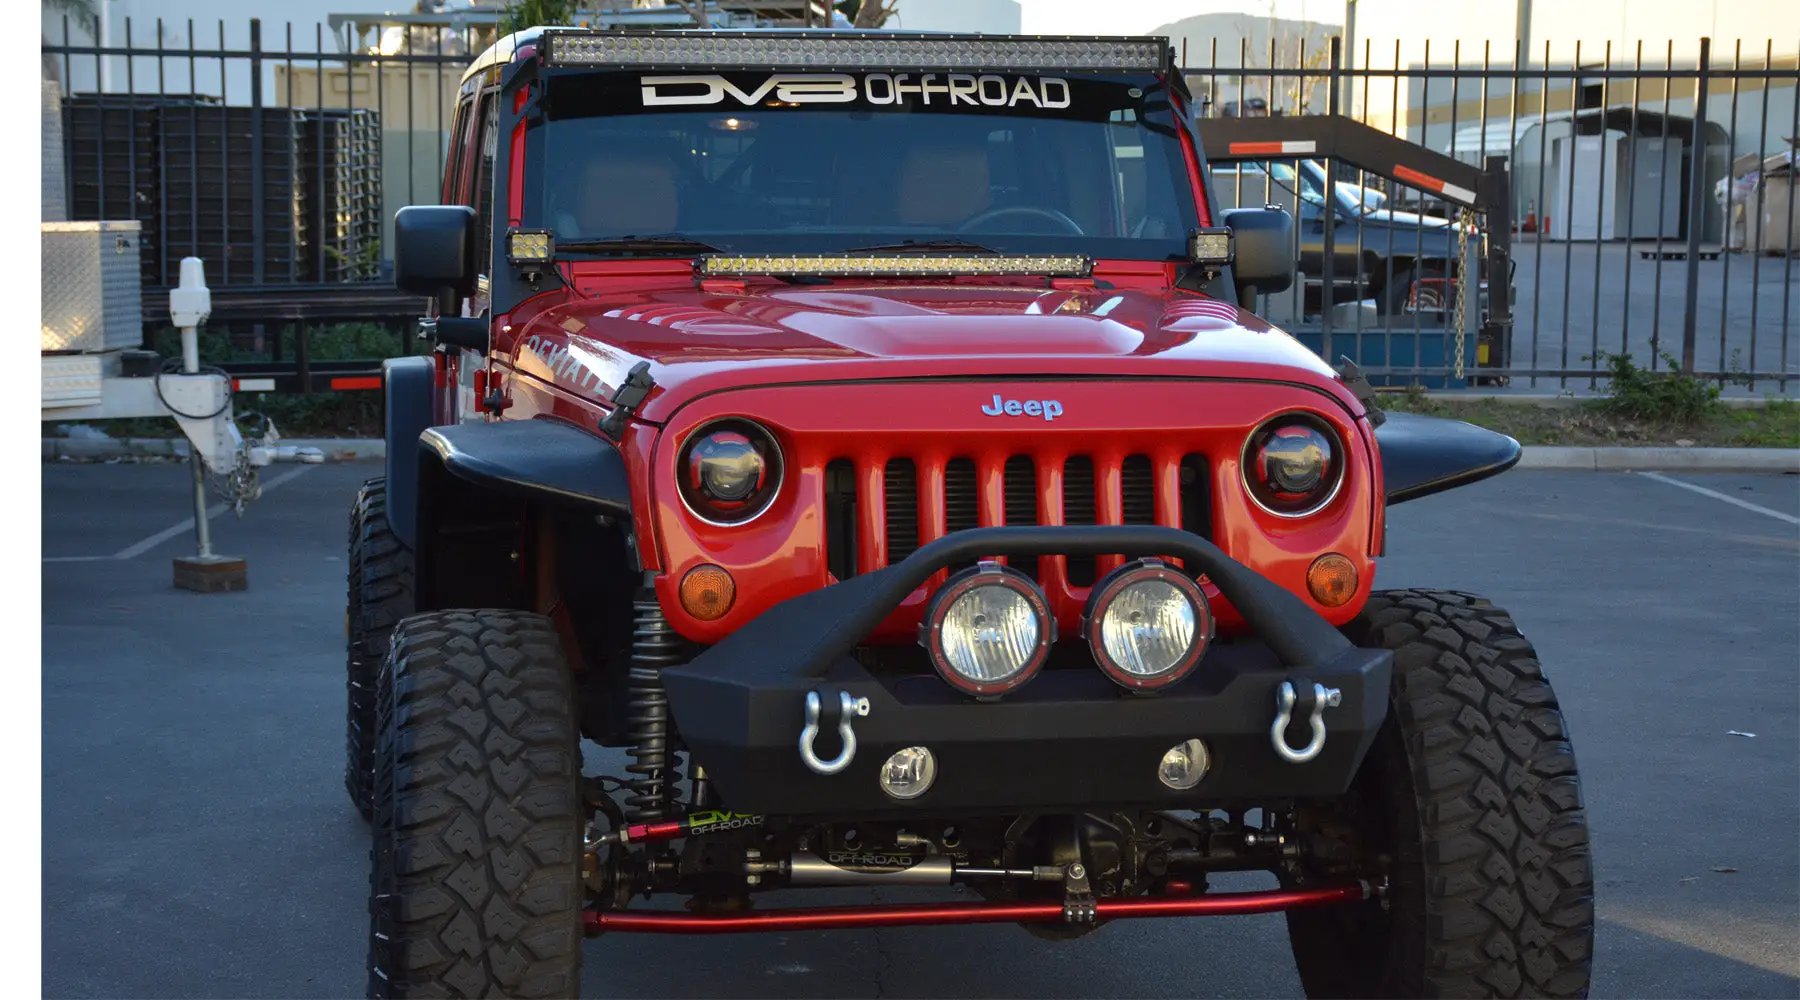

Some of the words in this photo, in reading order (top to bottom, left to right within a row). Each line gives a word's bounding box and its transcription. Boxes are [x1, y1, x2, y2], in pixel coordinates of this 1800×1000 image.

[641, 74, 857, 106] DV8
[865, 73, 1070, 109] OFFROAD
[981, 394, 1063, 421] Jeep
[829, 853, 912, 865] OFFROAD
